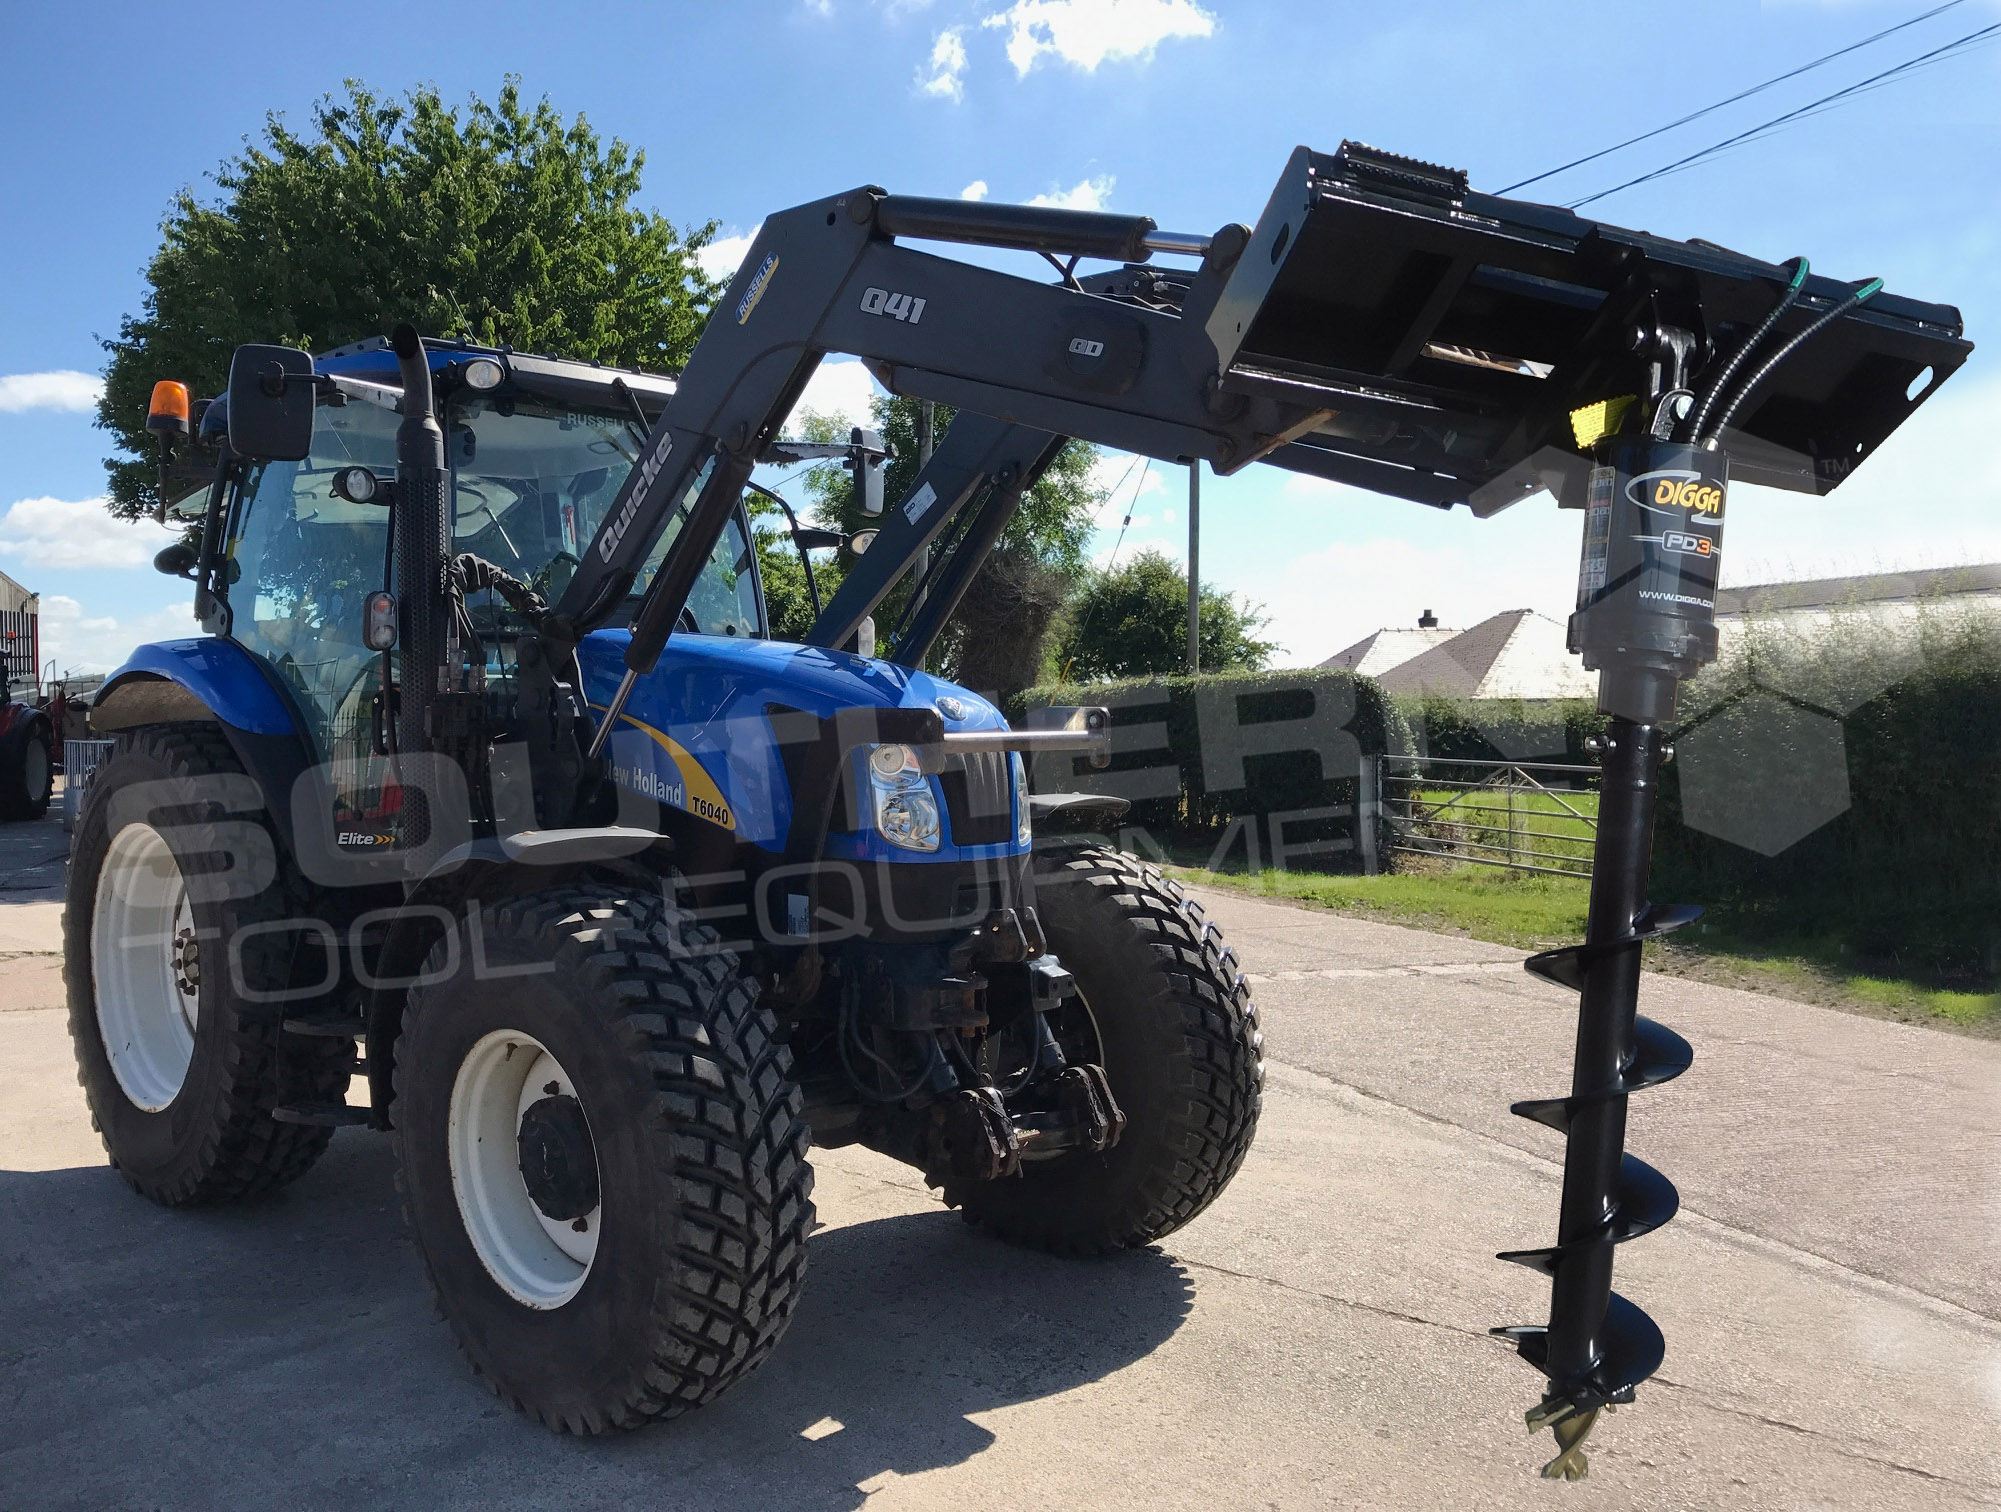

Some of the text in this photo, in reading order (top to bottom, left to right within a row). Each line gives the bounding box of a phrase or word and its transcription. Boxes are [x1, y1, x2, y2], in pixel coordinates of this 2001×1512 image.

[739, 257, 774, 316] RUSSELLS
[860, 287, 926, 324] Q41
[1069, 337, 1104, 357] QD
[599, 431, 673, 564] Quicke
[1654, 479, 1721, 514] DIGGA
[1666, 533, 1711, 555] PD3
[1639, 590, 1714, 608] WWW.DIGGA.CO
[633, 766, 682, 806] Holland
[692, 796, 729, 825] T6040
[337, 832, 375, 845] Elite
